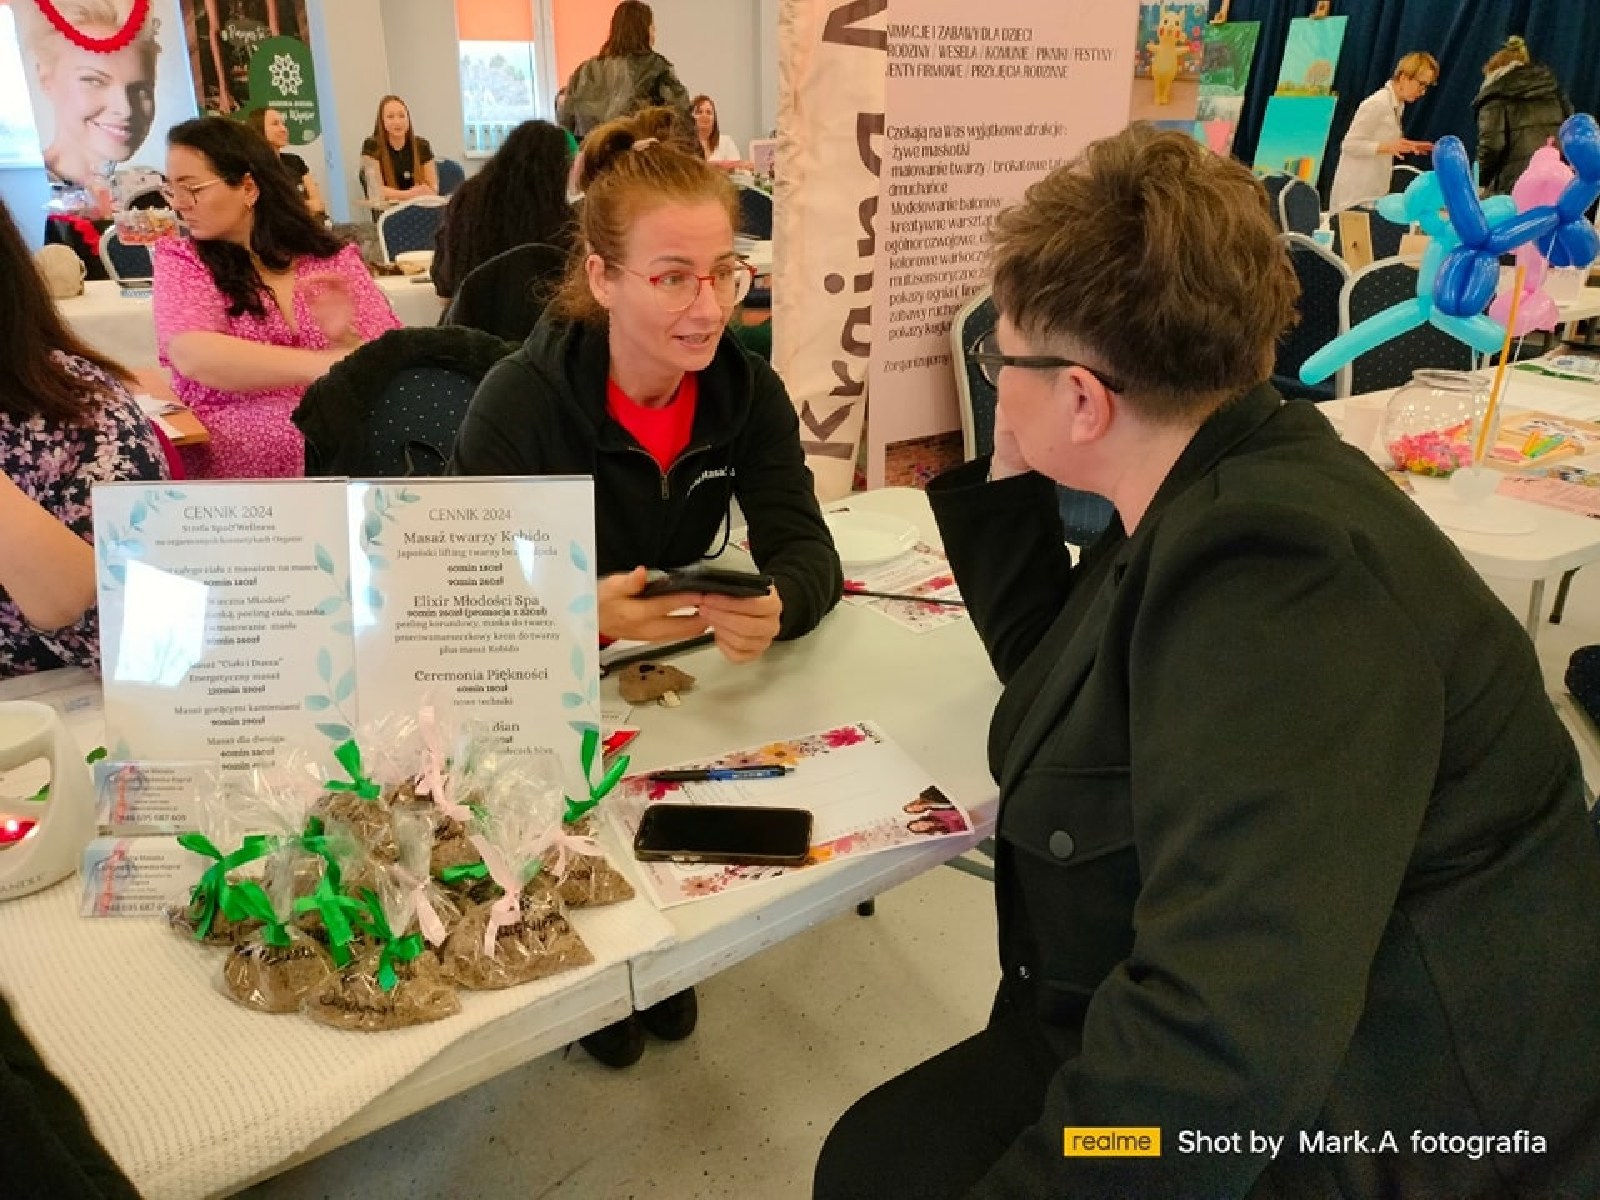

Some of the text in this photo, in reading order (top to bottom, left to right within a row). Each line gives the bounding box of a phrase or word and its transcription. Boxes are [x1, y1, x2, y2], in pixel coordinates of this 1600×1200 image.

[938, 26, 979, 40] ZABAWY
[981, 27, 1000, 41] DLA
[1002, 28, 1033, 41] DZIECI
[939, 45, 977, 59] WESELA
[985, 46, 1029, 60] KOMUNIE
[1075, 48, 1113, 62] FESTYNY
[917, 63, 963, 78] FIRMOWE
[1023, 65, 1068, 79] RODZINNE
[887, 125, 927, 141] Czekają
[929, 126, 943, 139] na
[944, 125, 965, 138] Was
[921, 141, 970, 158] maskotki
[891, 162, 947, 177] malowanie
[949, 162, 985, 177] twarzy
[993, 158, 1048, 174] brokatowe
[891, 198, 957, 215] Modelowanie
[889, 254, 937, 271] kolorowe
[183, 505, 273, 521] CENNIK 2024
[428, 508, 511, 521] CENNIK 2024
[403, 530, 447, 544] Masaż
[449, 532, 498, 546] twarzy
[413, 594, 540, 608] Elixir Młodości Spa
[414, 667, 549, 684] Ceremonia Piękności
